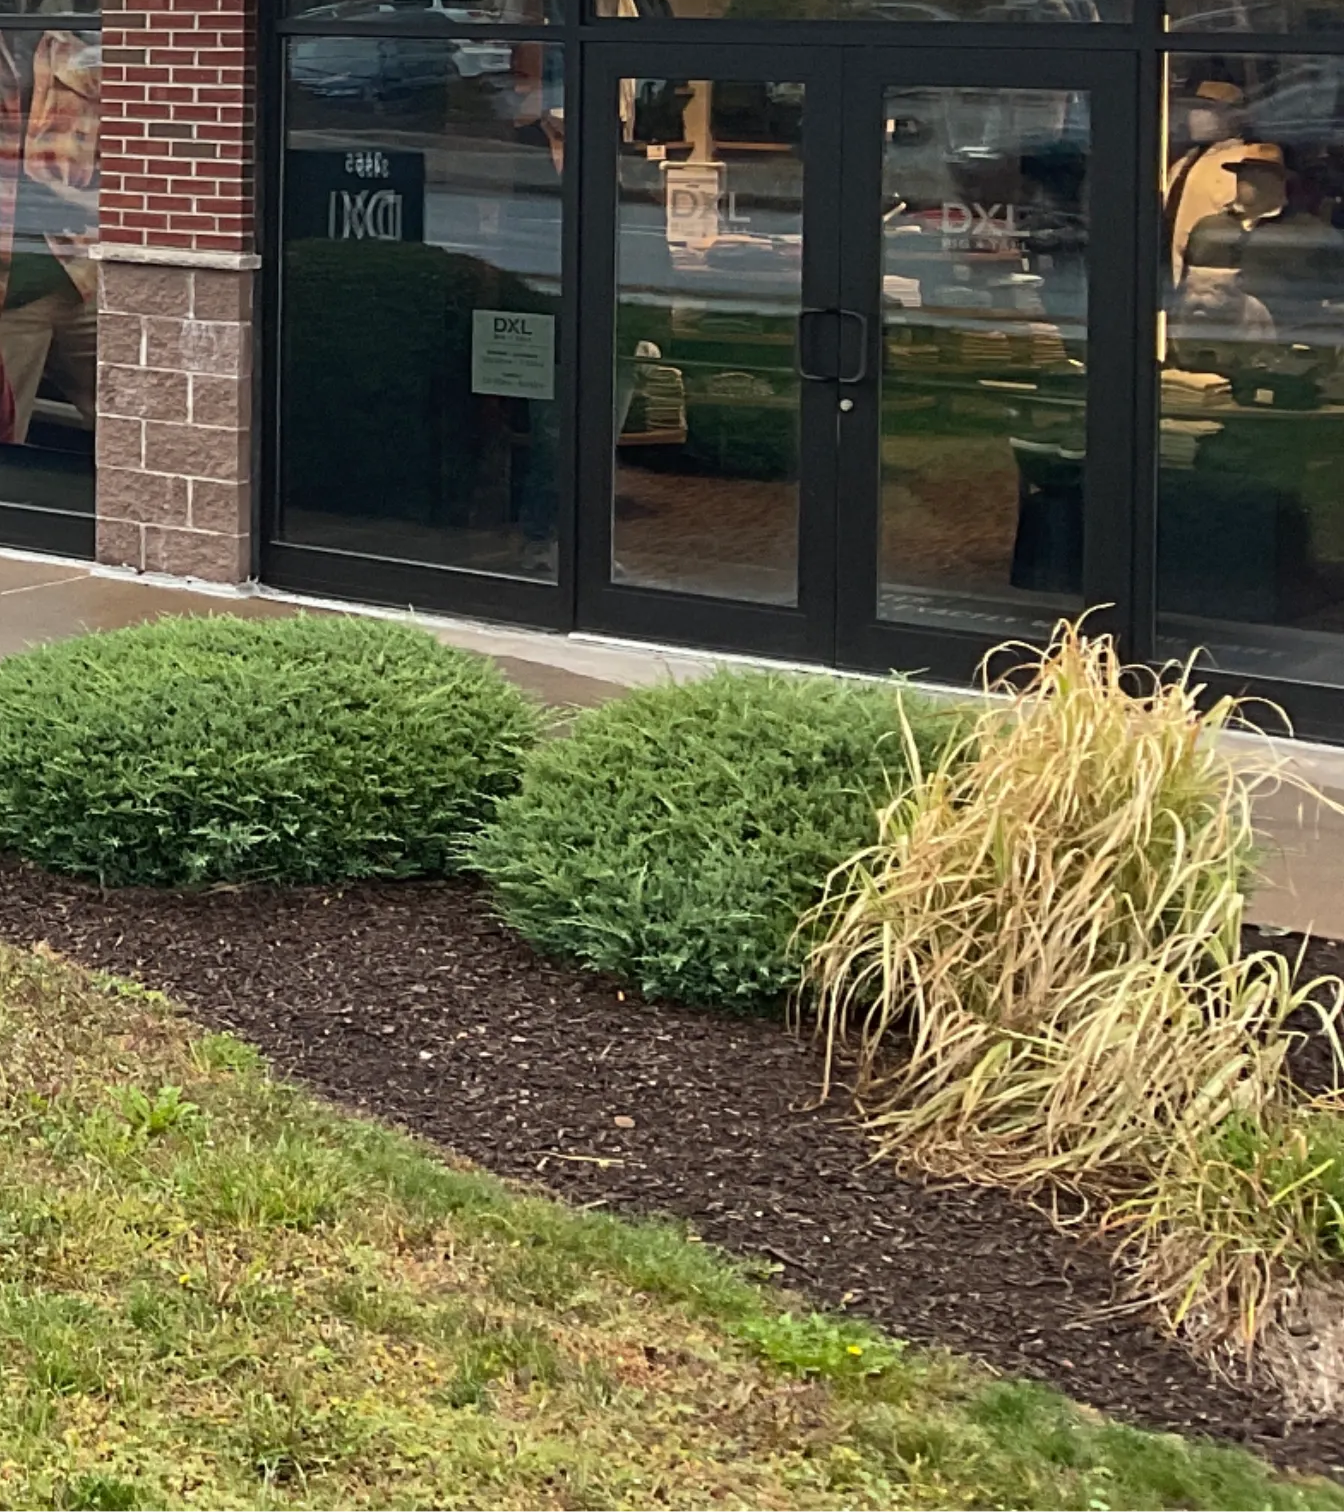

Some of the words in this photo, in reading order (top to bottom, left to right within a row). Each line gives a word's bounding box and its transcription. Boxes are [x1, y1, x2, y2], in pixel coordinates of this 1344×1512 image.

[671, 190, 750, 222] DXL
[942, 202, 1030, 237] DXL
[494, 318, 533, 335] DXL
